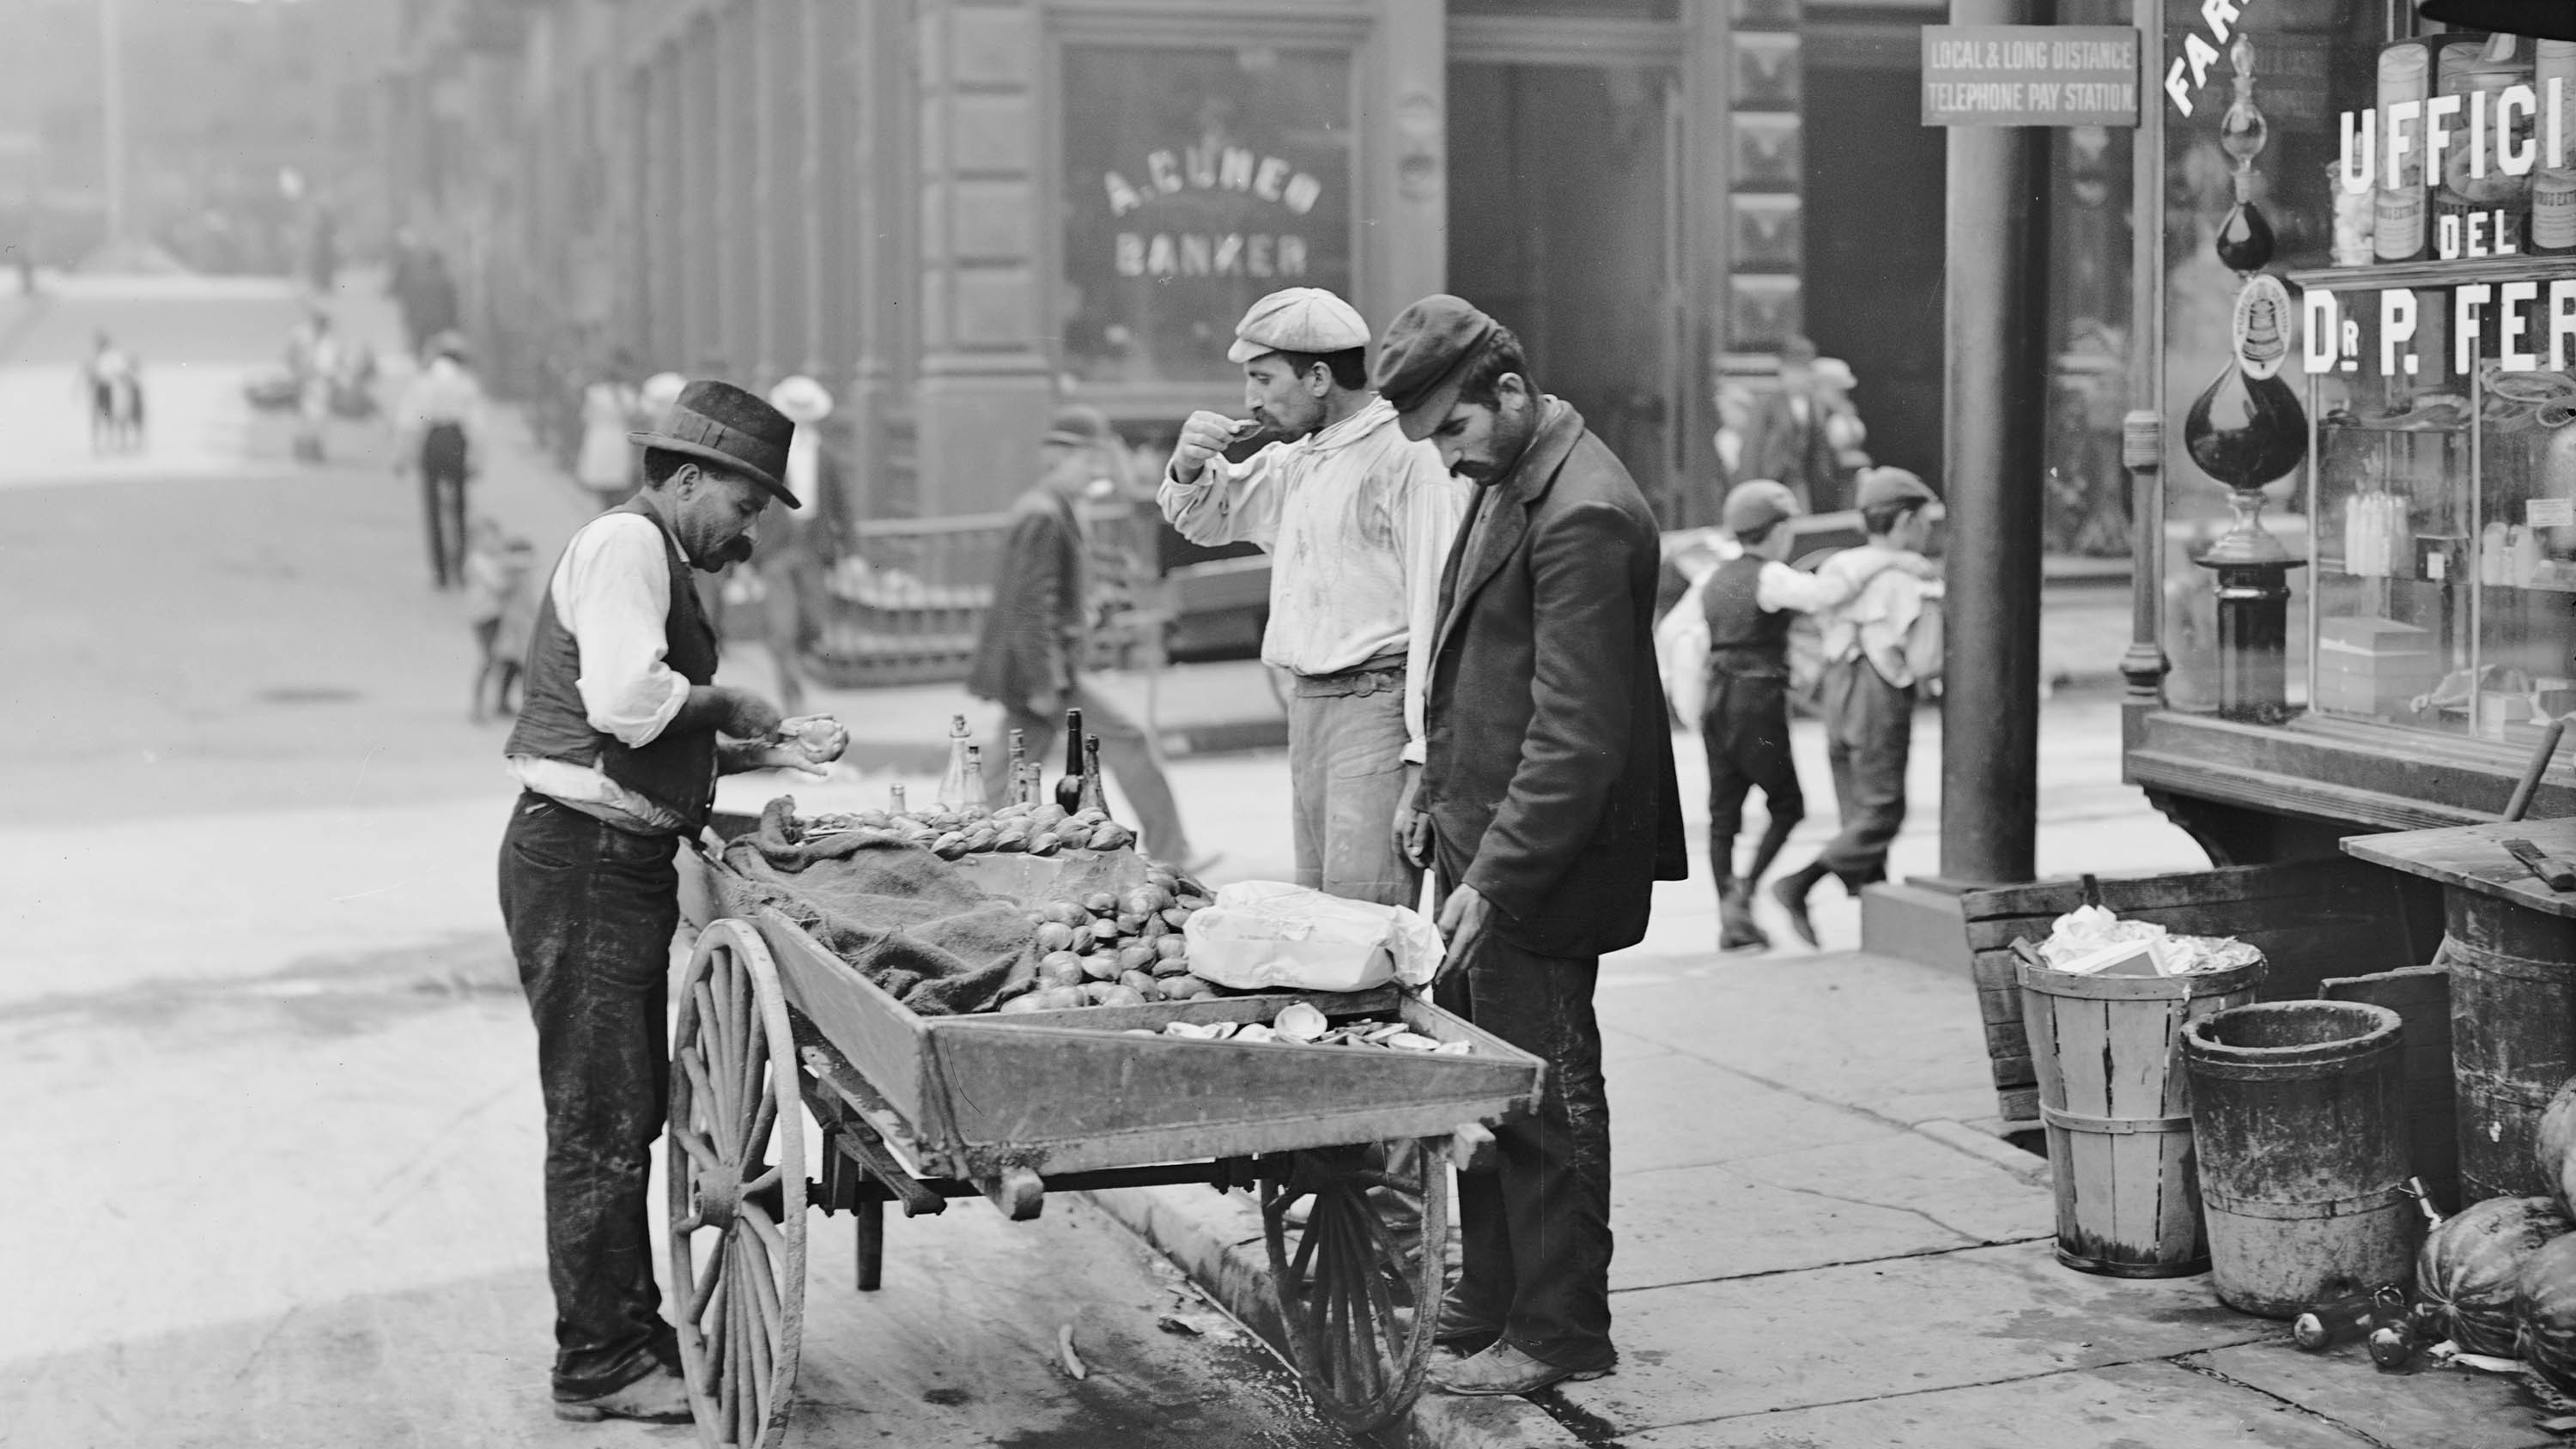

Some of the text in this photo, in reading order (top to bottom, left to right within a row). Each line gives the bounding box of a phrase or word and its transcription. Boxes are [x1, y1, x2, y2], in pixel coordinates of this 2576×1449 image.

[1932, 40, 2131, 69] LOCAL & LONG DISTANCE
[2164, 0, 2251, 118] FAR
[1929, 82, 2023, 111] TELEPHONE
[2028, 82, 2061, 111] PAY
[2339, 76, 2563, 194] UFFICI
[1116, 233, 1308, 278] BANKER
[2439, 209, 2517, 260] DEL
[2380, 288, 2419, 376] P.
[2455, 279, 2576, 375] FER
